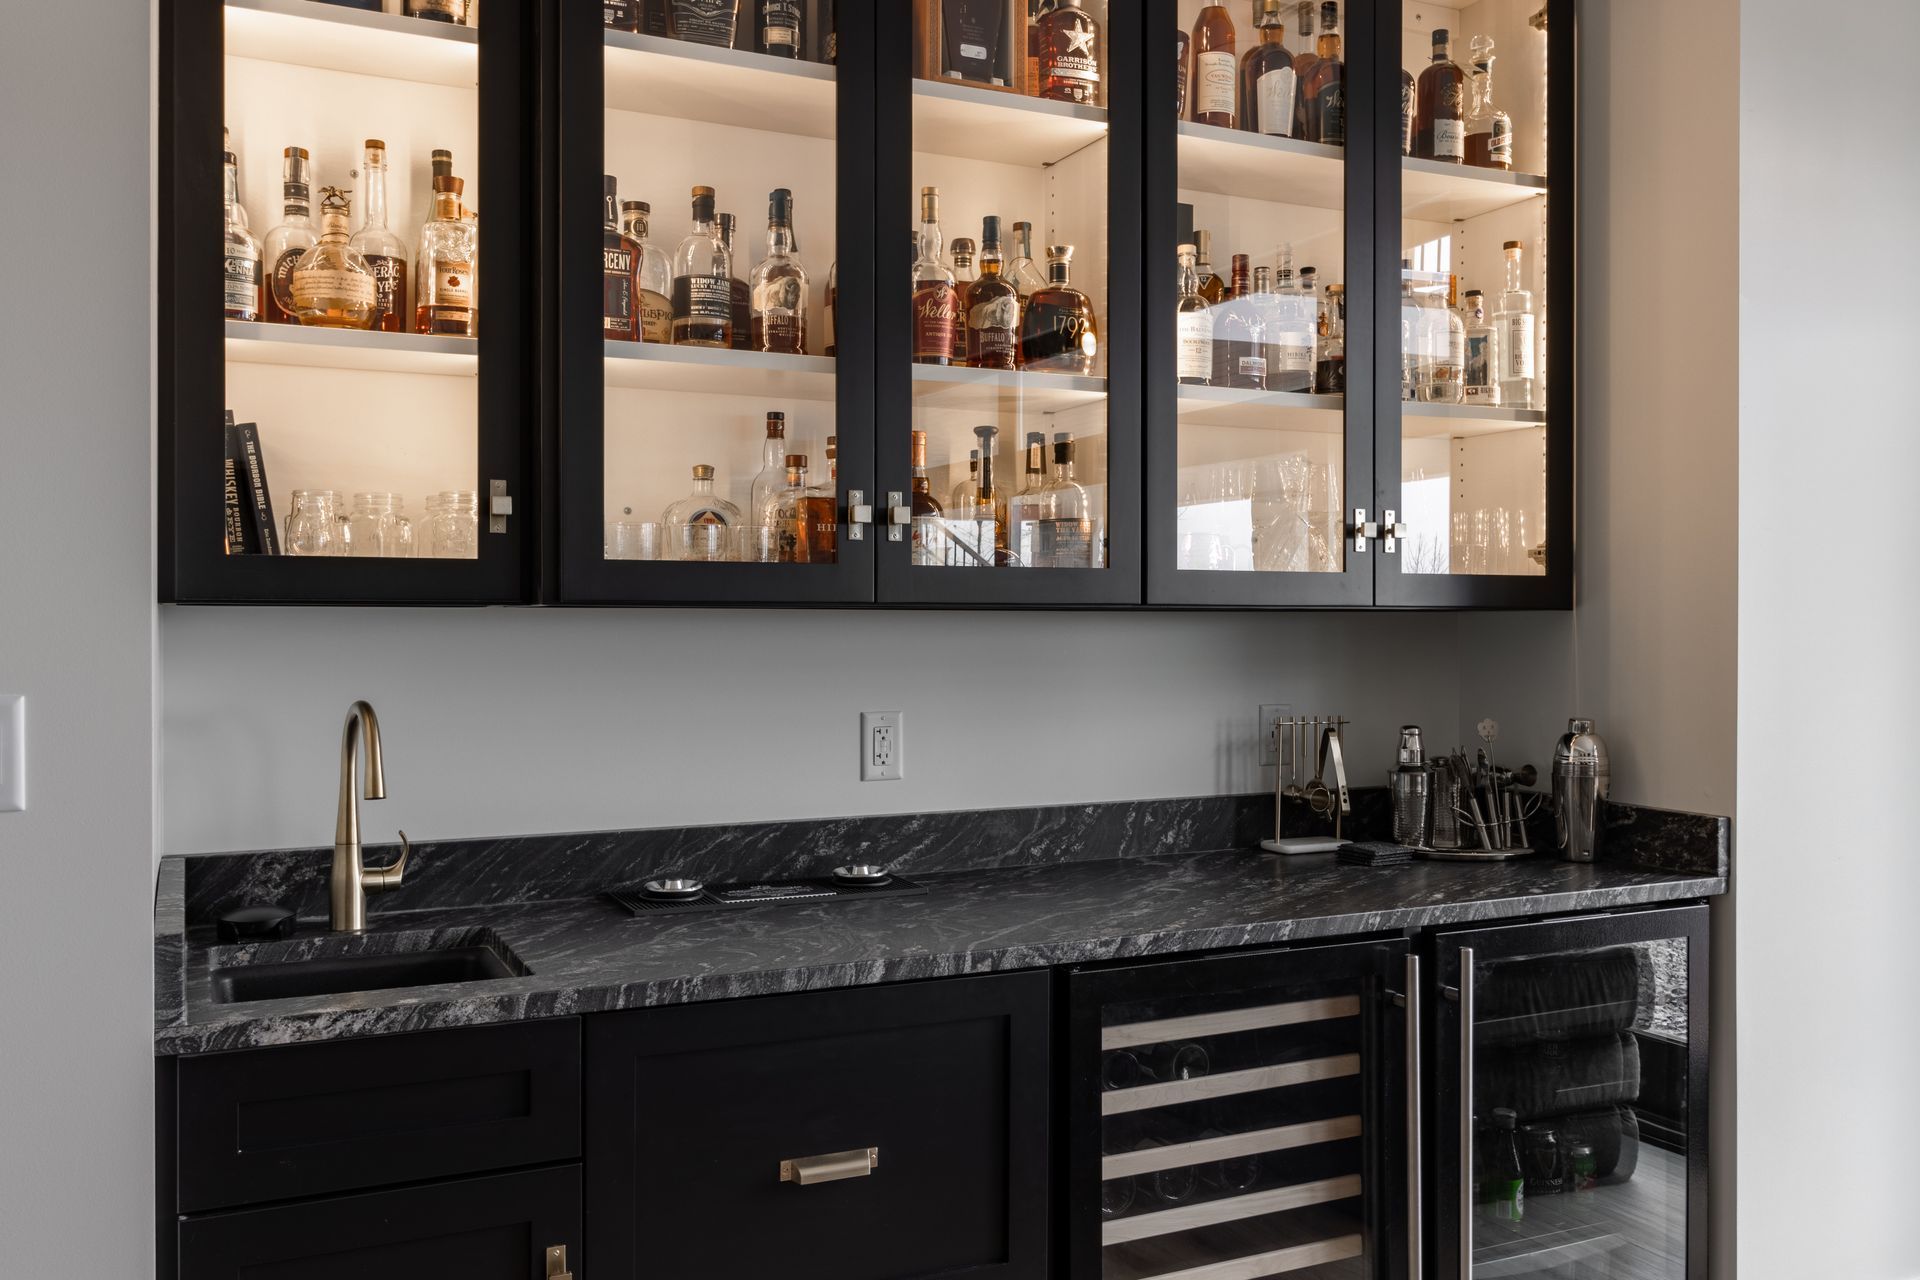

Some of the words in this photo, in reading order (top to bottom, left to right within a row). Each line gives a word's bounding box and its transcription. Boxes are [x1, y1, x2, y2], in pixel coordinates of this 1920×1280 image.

[1056, 55, 1097, 67] GARRISON
[372, 265, 400, 279] ERAC
[690, 277, 716, 286] WIDOW
[1053, 314, 1087, 339] 1792
[246, 441, 256, 454] THE
[249, 455, 262, 488] BOURBON
[225, 458, 239, 506] WHISKEY
[255, 488, 267, 510] BIBLE
